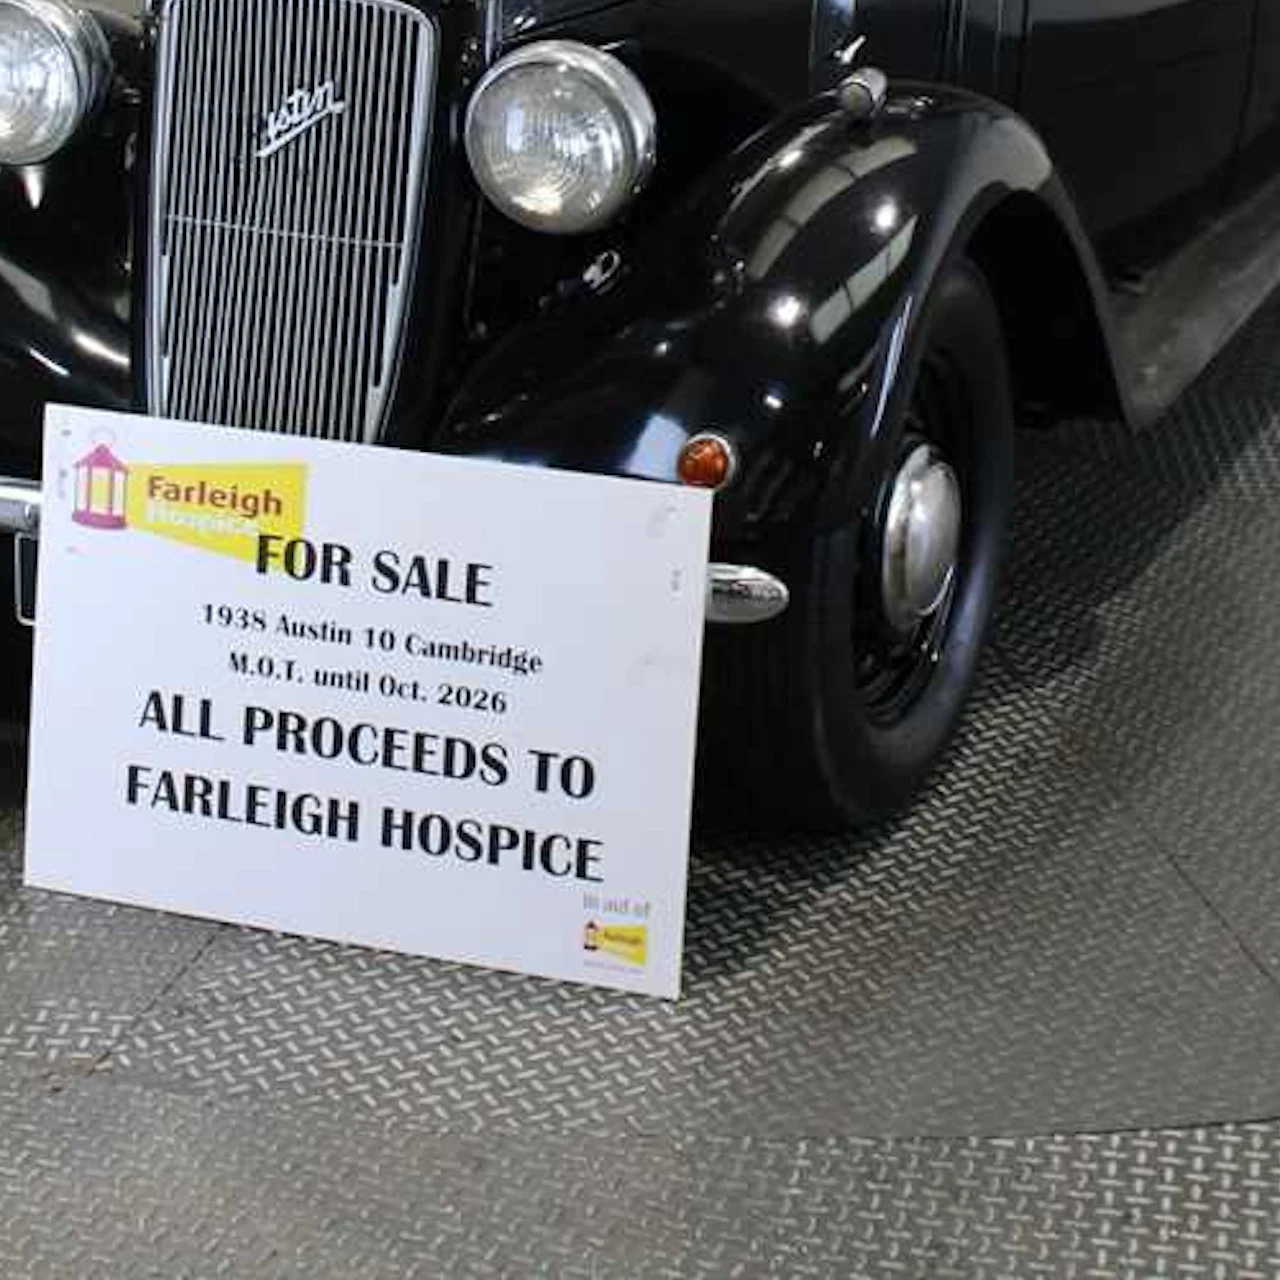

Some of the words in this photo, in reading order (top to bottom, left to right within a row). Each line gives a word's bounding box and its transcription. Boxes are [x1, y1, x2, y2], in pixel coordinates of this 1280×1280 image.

[147, 474, 283, 518] Farleigh
[256, 532, 352, 587] FOR
[372, 548, 494, 608] SALE
[203, 603, 267, 632] 1938
[277, 614, 352, 646] Austin
[365, 627, 396, 652] 10
[404, 633, 543, 676] Cambridge
[228, 650, 304, 683] M.O.T.
[314, 667, 370, 694] until
[379, 675, 427, 704] Oct.
[437, 682, 508, 714] 2026
[138, 689, 226, 742] ALL
[242, 704, 509, 787] PROCEEDS
[528, 749, 596, 800] TO
[124, 763, 360, 843] FARLEIGH
[380, 806, 606, 883] HOSPICE
